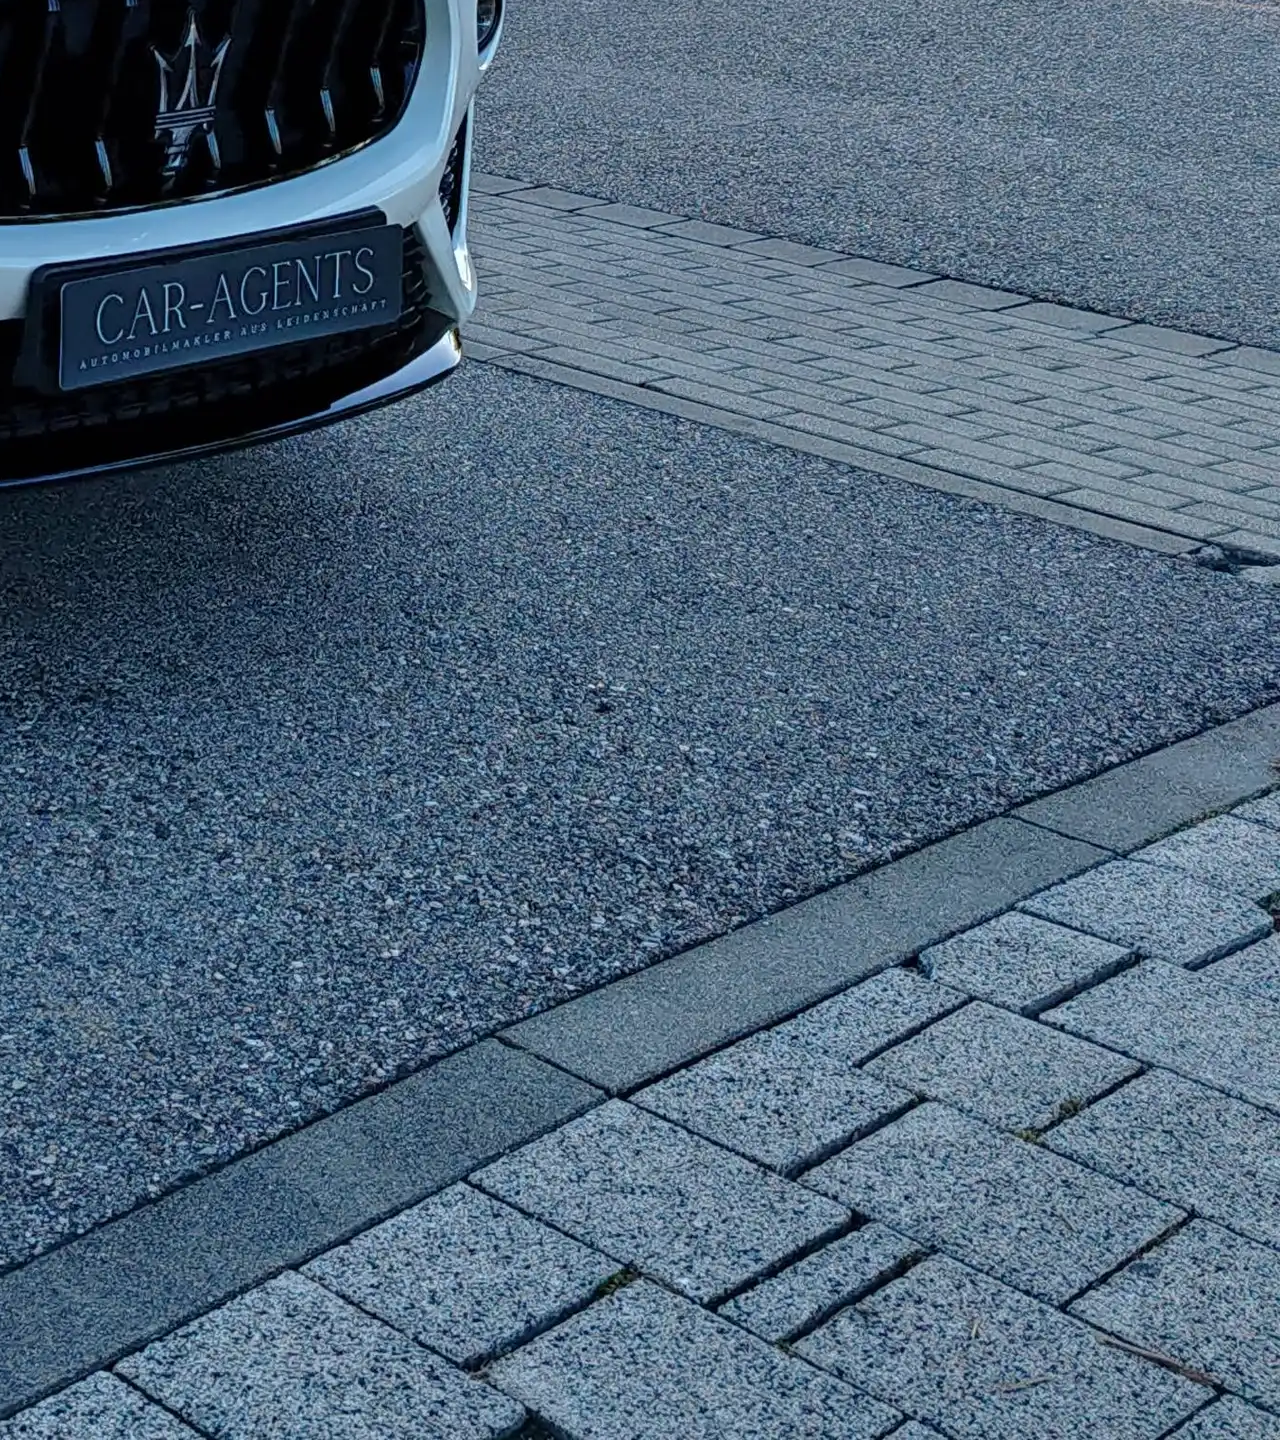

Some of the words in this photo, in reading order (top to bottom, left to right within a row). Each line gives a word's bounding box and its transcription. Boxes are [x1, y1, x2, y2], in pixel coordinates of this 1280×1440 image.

[79, 329, 232, 370] AUTOMOBILMAKLER
[240, 321, 268, 337] AUS
[276, 298, 388, 330] LEIDENSCHAFT
[96, 246, 375, 345] CAR-AGENTS
